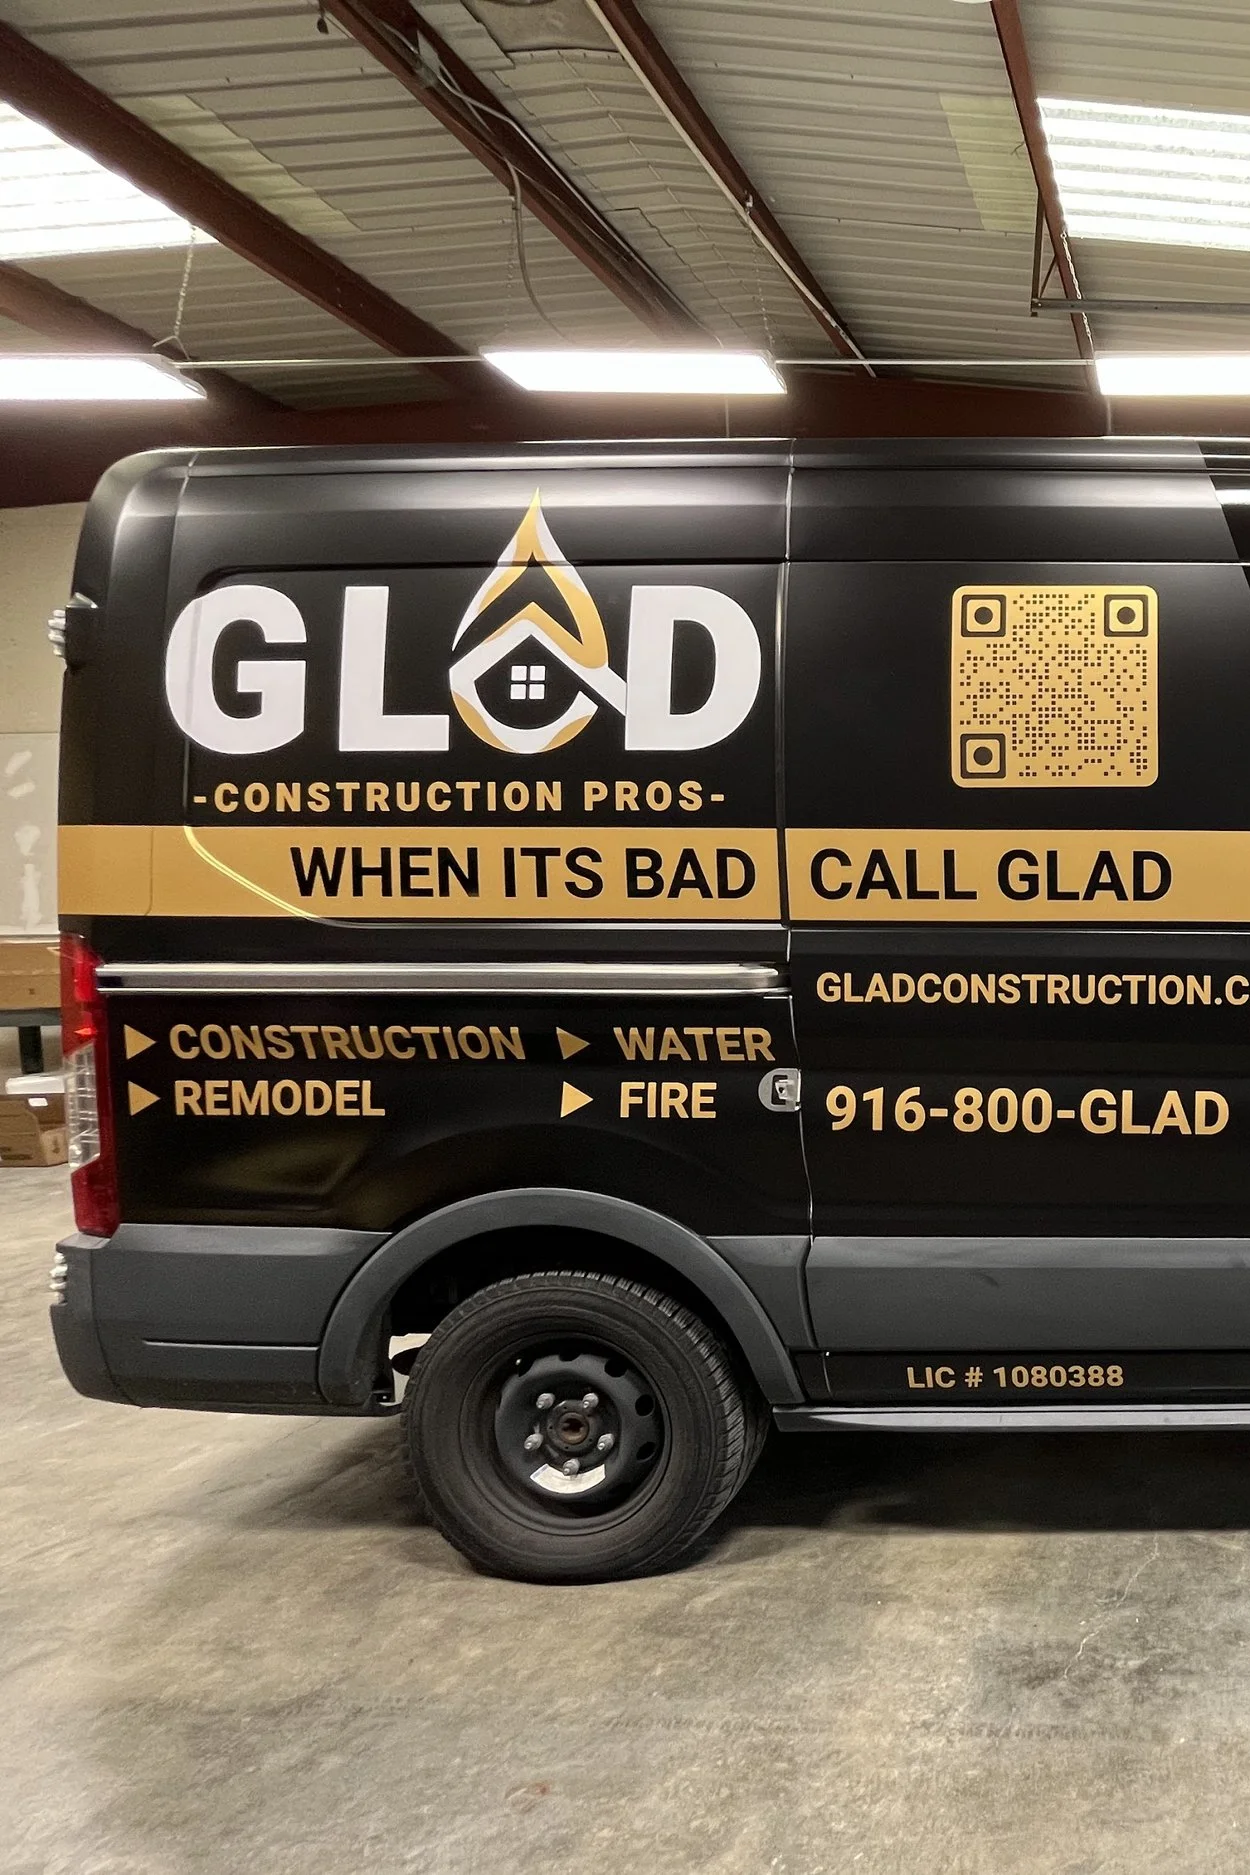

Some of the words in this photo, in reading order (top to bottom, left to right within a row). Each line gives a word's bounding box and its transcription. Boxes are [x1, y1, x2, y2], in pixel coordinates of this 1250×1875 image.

[165, 486, 761, 755] GLAD
[290, 846, 480, 898] WHEN
[503, 846, 604, 899] ITS
[625, 847, 756, 899] BAD
[810, 849, 978, 900] CALL
[997, 849, 1172, 902] GLAD
[169, 1023, 526, 1060] CONSTRUCTION
[613, 1026, 776, 1062] WATER
[174, 1079, 386, 1117] REMODEL
[619, 1081, 718, 1119] FIRE
[825, 1085, 1230, 1136] 916-800-GLAD
[906, 1366, 956, 1388] LIC
[964, 1366, 984, 1388] #
[993, 1365, 1124, 1388] 1080388
